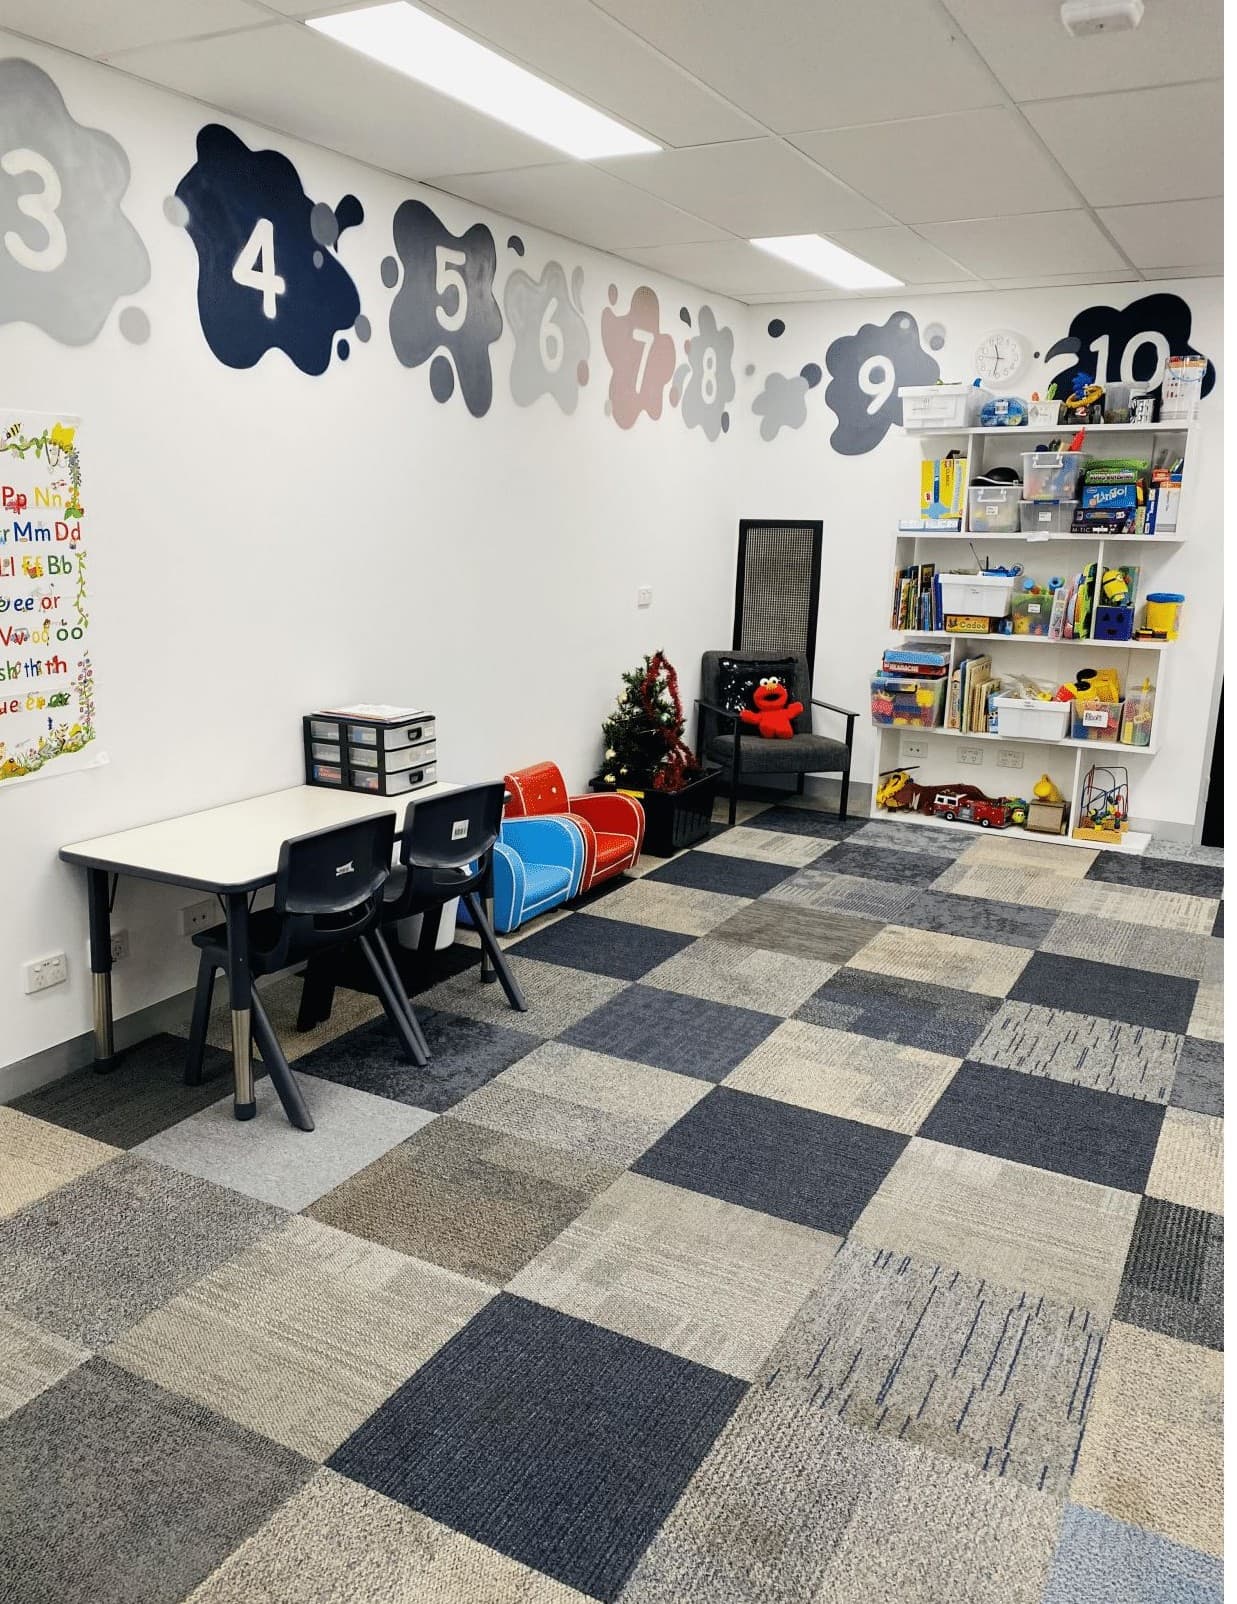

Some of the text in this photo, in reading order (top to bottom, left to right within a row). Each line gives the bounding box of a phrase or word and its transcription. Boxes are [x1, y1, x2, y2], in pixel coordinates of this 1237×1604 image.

[1, 147, 68, 272] 3
[231, 217, 287, 320] 4
[435, 246, 469, 332] 5
[539, 297, 564, 373] 6
[631, 328, 657, 394] 7
[1089, 330, 1170, 393] 10
[702, 346, 719, 406] 8
[858, 354, 896, 416] 9
[2, 486, 63, 515] Pp Nn
[13, 521, 51, 542] Mm
[55, 521, 81, 542] Dd
[47, 554, 73, 575] Bb
[13, 597, 35, 612] ee
[41, 595, 61, 610] or
[56, 626, 84, 642] oo
[24, 658, 40, 678] th
